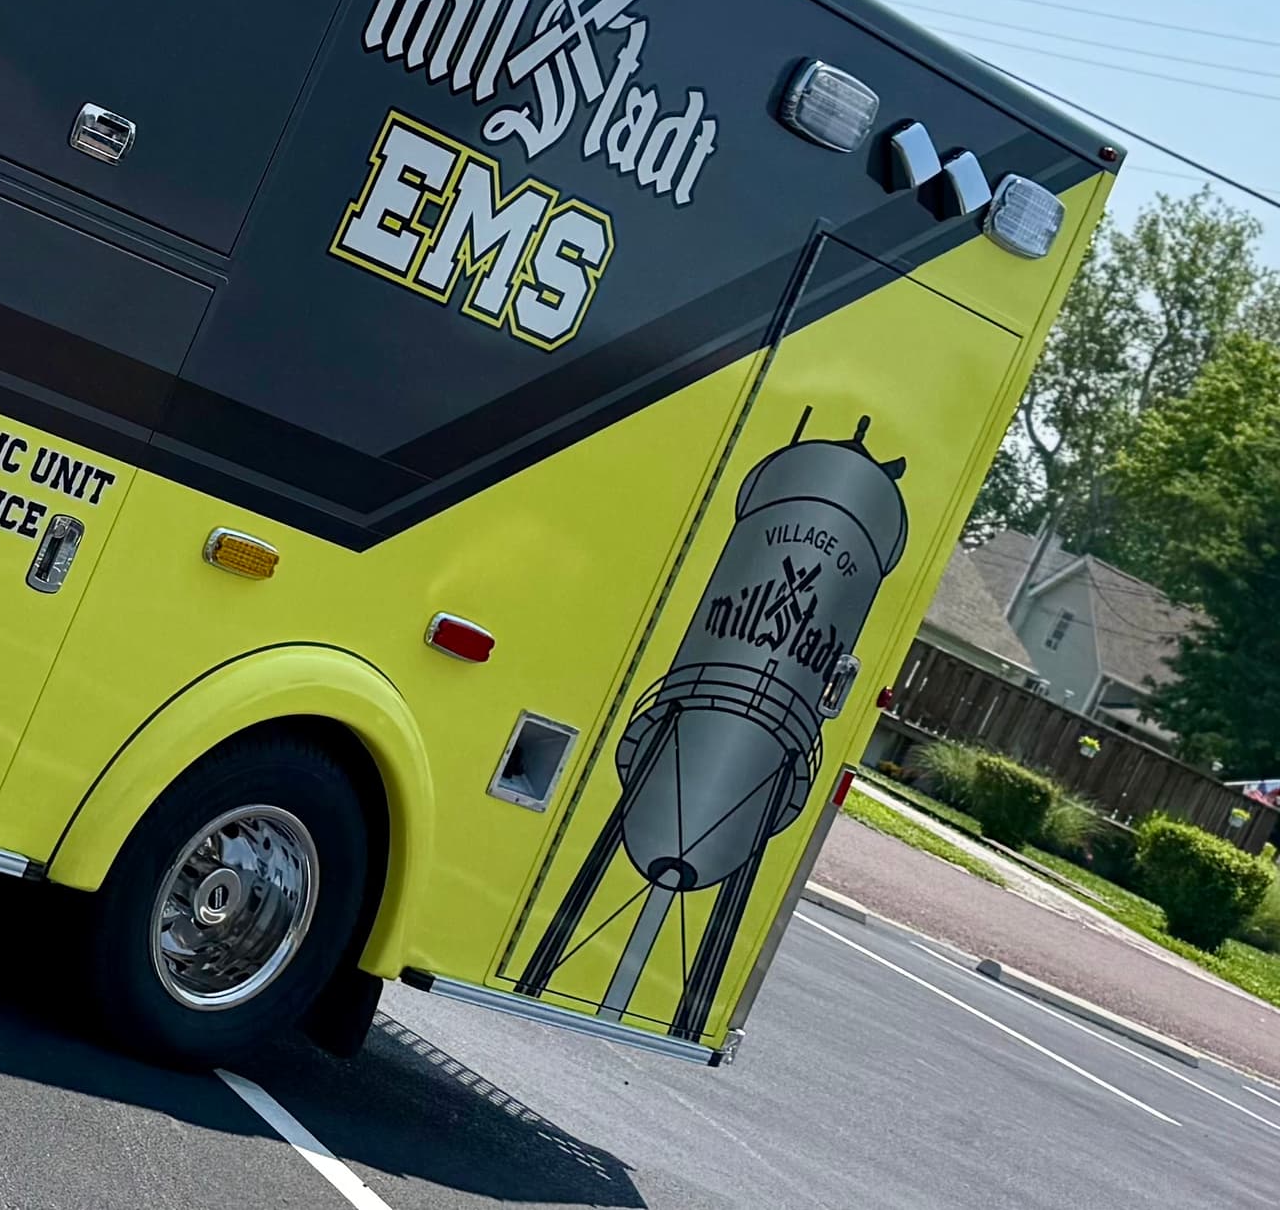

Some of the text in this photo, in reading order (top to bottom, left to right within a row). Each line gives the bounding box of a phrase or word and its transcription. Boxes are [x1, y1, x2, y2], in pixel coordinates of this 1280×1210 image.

[331, 112, 614, 348] EMS
[30, 446, 116, 506] UNIT
[765, 523, 858, 579] VILLAGE OF
